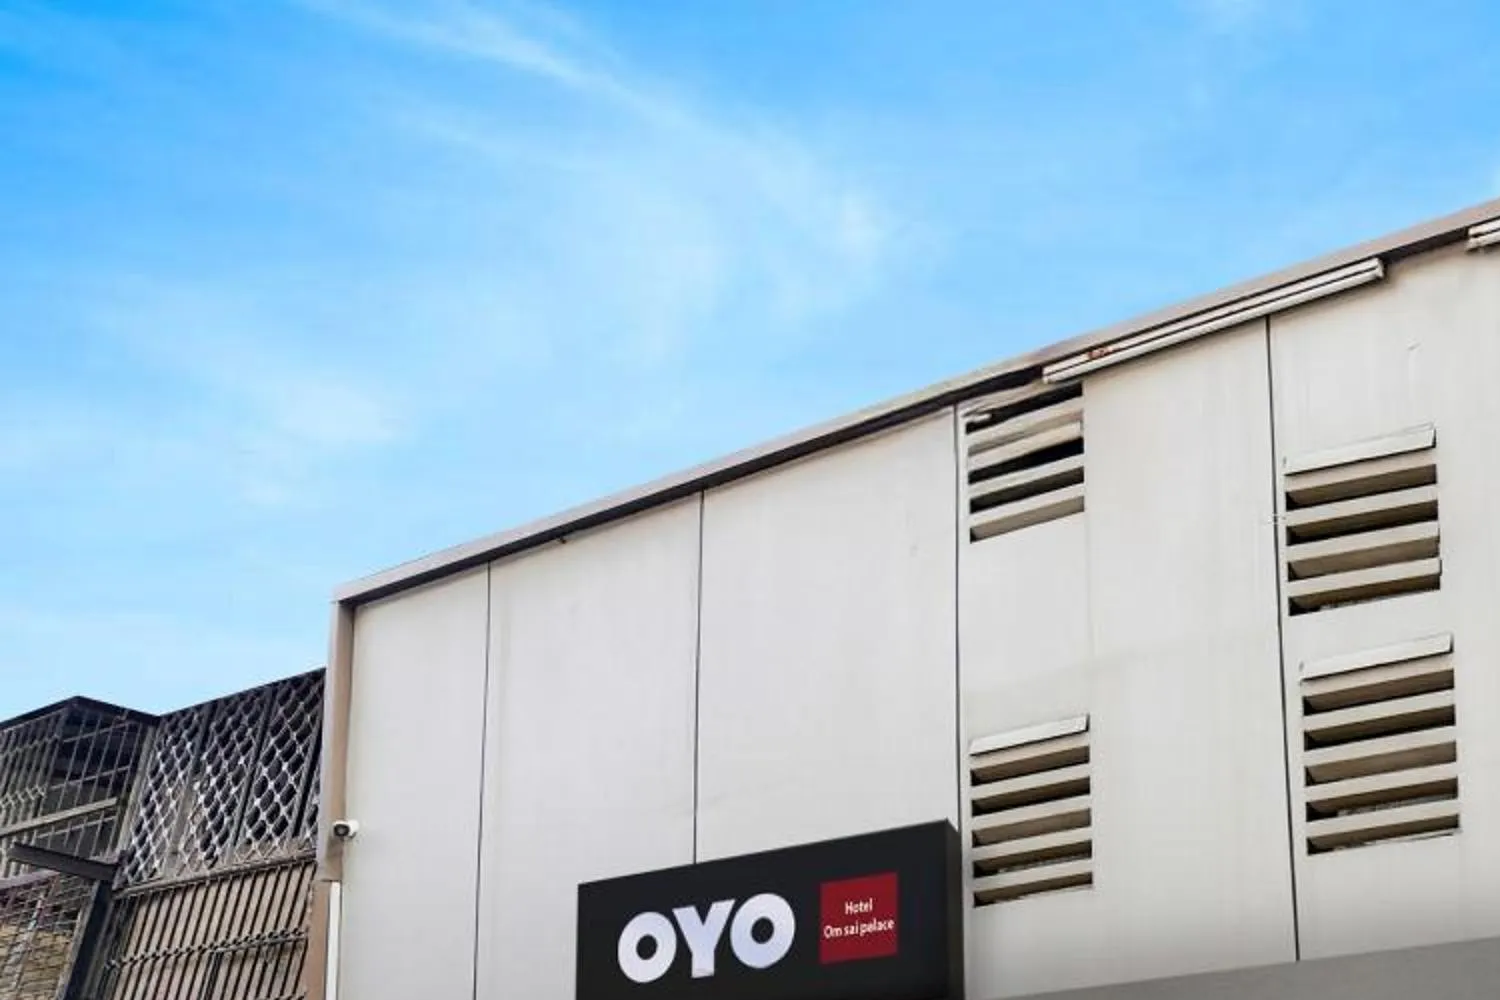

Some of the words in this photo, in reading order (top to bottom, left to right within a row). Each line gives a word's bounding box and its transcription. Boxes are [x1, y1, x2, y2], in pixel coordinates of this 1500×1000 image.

[844, 897, 873, 915] Hotel
[618, 893, 795, 983] OYO
[823, 925, 842, 939] Om
[844, 920, 859, 936] sai
